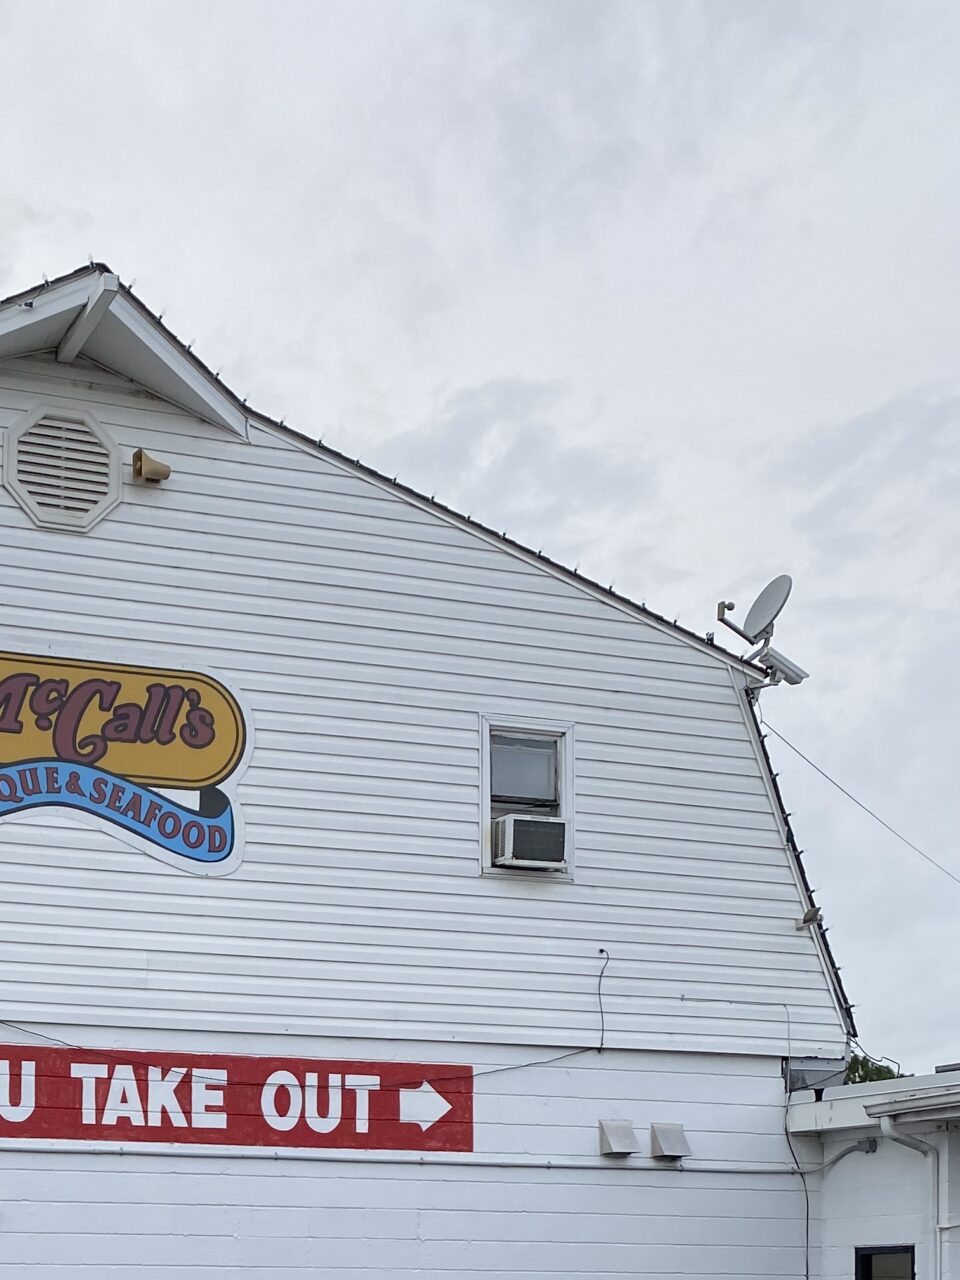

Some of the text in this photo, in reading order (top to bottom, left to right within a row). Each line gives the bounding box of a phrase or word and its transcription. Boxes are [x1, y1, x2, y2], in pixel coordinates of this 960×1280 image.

[89, 776, 228, 853] SEAFOOD
[70, 1063, 227, 1129] TAKE
[260, 1070, 381, 1134] OUT
